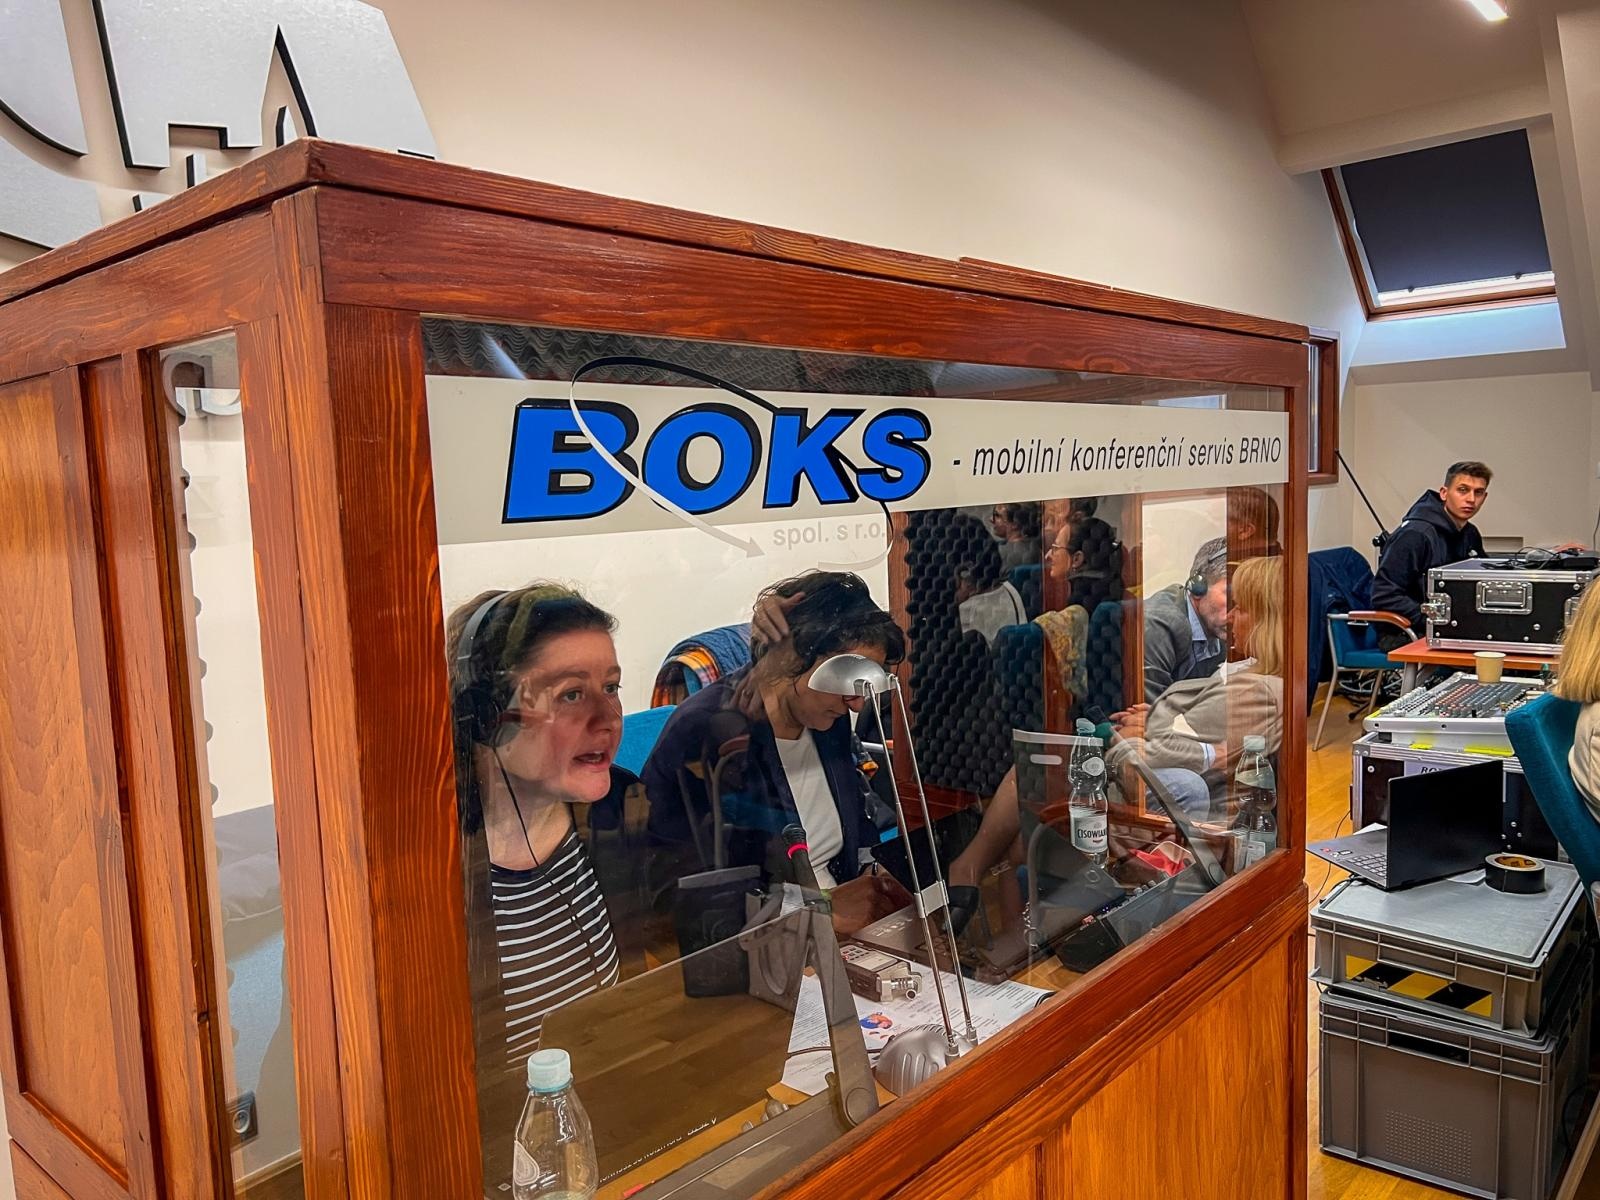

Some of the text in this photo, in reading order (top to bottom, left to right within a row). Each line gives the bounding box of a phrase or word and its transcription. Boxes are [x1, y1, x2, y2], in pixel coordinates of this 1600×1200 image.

[502, 398, 931, 523] BOKS
[973, 438, 1065, 476] mobilní
[1070, 437, 1185, 472] konferenční
[1188, 437, 1234, 467] servis
[1239, 436, 1282, 464] BRNO
[773, 521, 829, 550] spol.
[836, 524, 849, 541] s
